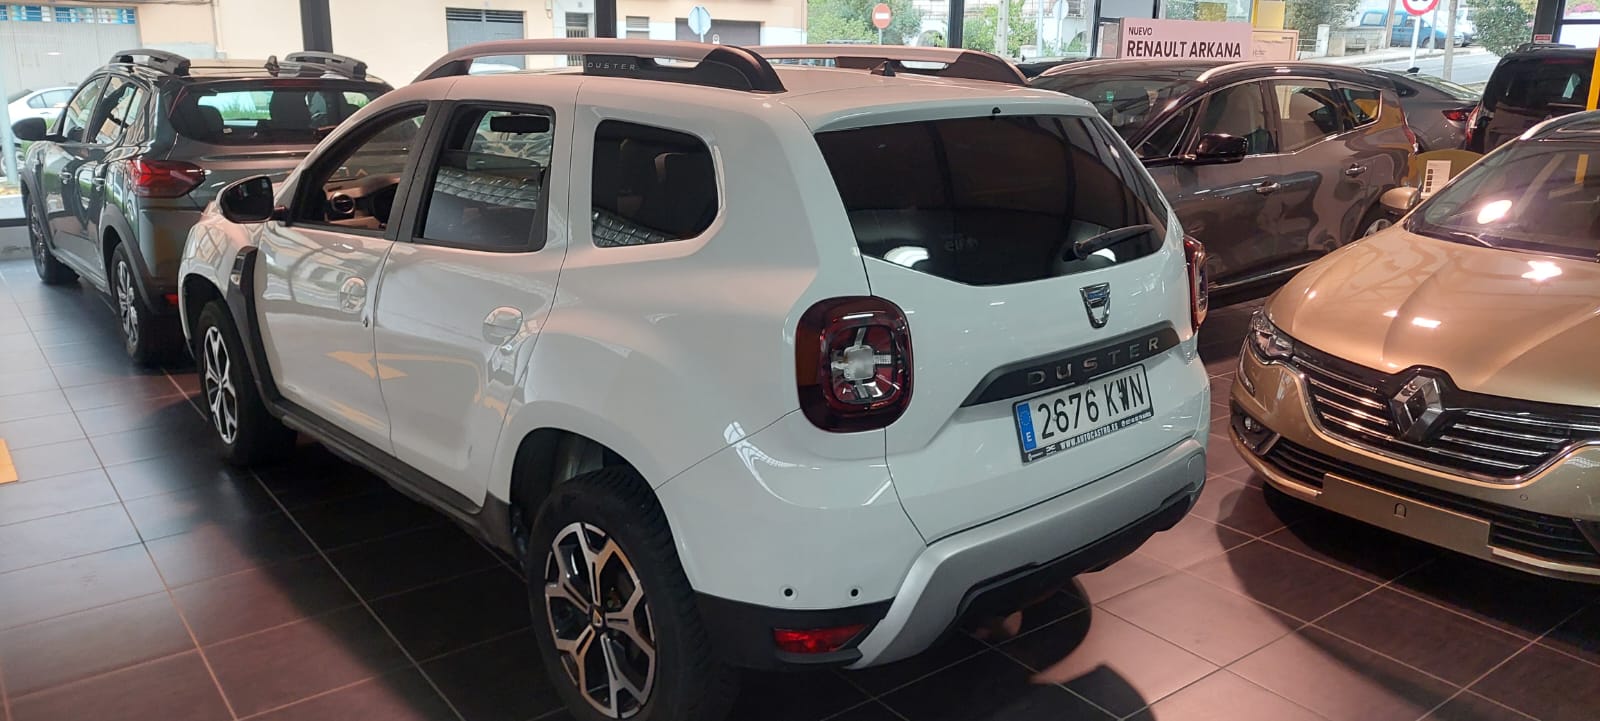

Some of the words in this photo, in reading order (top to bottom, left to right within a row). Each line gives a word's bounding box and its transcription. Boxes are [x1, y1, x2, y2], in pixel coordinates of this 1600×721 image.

[1128, 26, 1153, 36] NUEVO
[1126, 40, 1187, 58] RENAULT
[1189, 42, 1242, 58] ARKANA
[587, 62, 636, 71] DUSTER
[1027, 337, 1160, 386] DUSTER
[1037, 388, 1100, 440] 2676
[1103, 373, 1145, 417] KWN
[1025, 431, 1033, 442] E
[1059, 422, 1119, 451] WWW.AUTOCASTRO.ES
